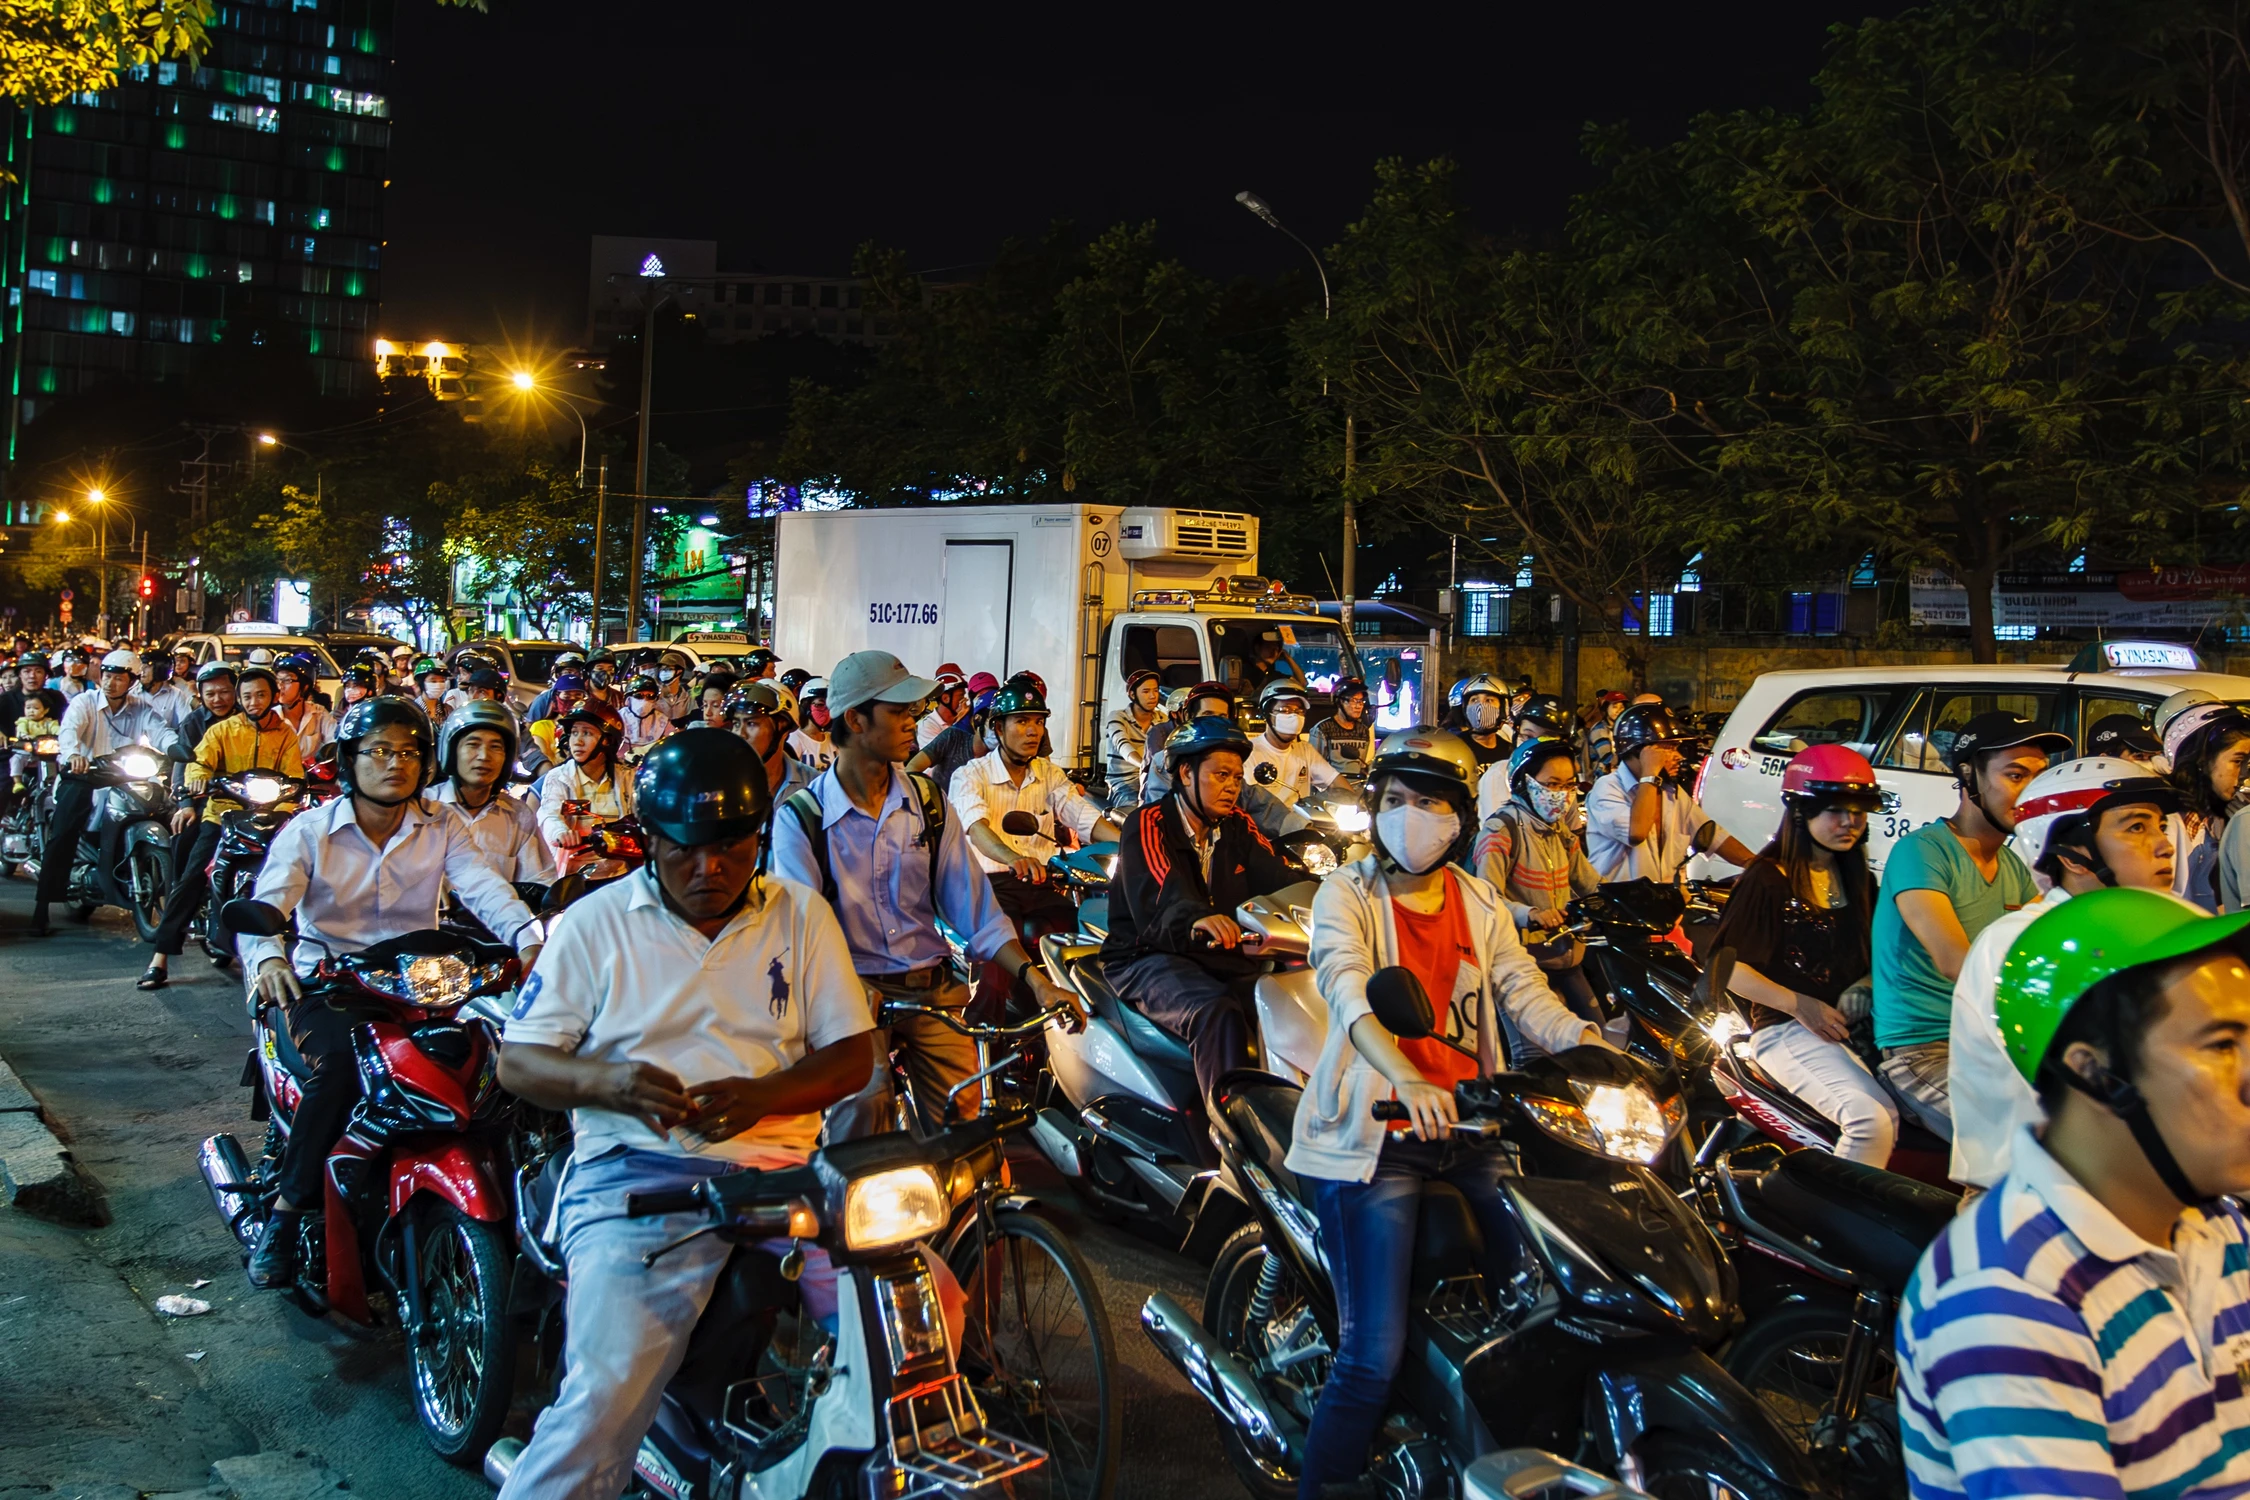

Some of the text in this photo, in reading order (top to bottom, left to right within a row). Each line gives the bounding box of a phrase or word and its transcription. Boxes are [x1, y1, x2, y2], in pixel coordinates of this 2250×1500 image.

[1094, 538, 1108, 551] 07
[869, 603, 938, 624] 51C-177.66
[1554, 1317, 1602, 1344] HONDA
